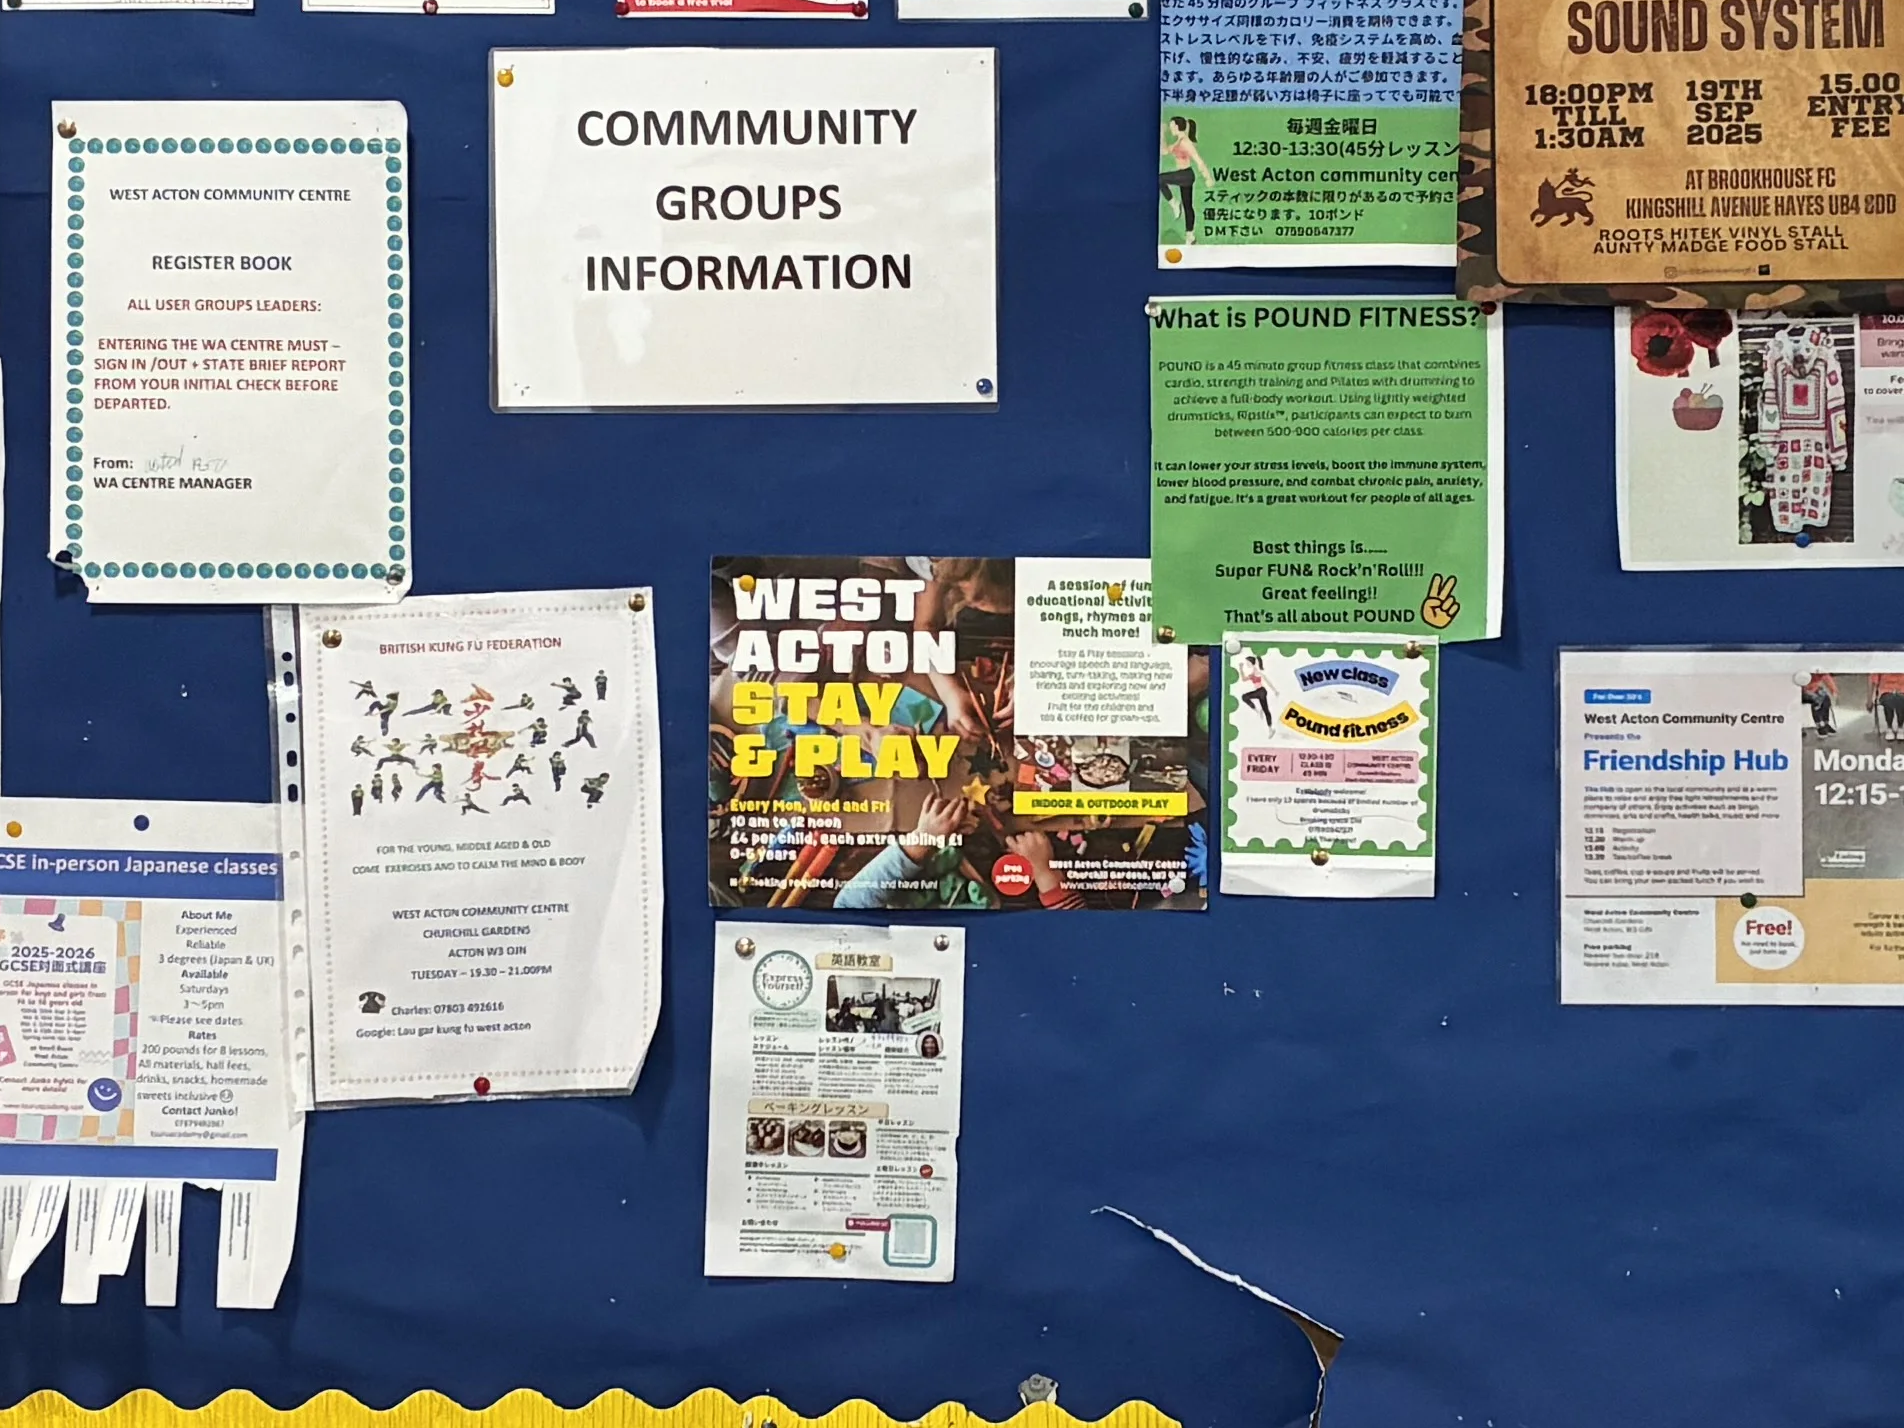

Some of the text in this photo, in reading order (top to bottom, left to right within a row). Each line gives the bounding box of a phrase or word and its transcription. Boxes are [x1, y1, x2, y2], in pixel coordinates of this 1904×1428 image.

[1567, 0, 1708, 54] SOUND
[1524, 83, 1654, 106] 18:00PM
[1686, 80, 1763, 101] 19TH
[1819, 73, 1900, 95] 15.00
[1552, 105, 1628, 127] TILL
[1695, 102, 1754, 123] SEP
[578, 108, 917, 146] COMMMUNITY
[1287, 117, 1377, 136] 毎週金曜日
[1535, 126, 1645, 149] 1:30AM
[1686, 123, 1763, 145] 2025
[1831, 117, 1891, 138] FEE
[1685, 167, 1836, 190] AT BROOKHOUSE FC
[109, 188, 351, 201] WEST ACTON COMMUNITY CENTRE
[656, 184, 842, 221] GROUPS
[1626, 197, 1706, 219] KINGSHILL
[1711, 196, 1771, 217] AVENUE
[1774, 195, 1823, 216] HAYES
[1829, 194, 1861, 215] UB4
[1599, 225, 1843, 241] ROOTS HITEK VINYL STALL
[1593, 237, 1849, 254] AUNTY MADGE FOOD STALL
[152, 255, 292, 271] REGISTER BOOK
[586, 253, 911, 291] INFORMATION
[127, 298, 321, 312] ALL USER GROUPS LEADERS:
[1155, 306, 1481, 329] What is POUND FITNESS?
[733, 578, 925, 621] WEST
[379, 636, 561, 655] BRITISH KUNG FU FEDERATION
[732, 630, 956, 675] ACTON
[1300, 667, 1390, 689] New class
[733, 682, 902, 726] STAY
[1284, 708, 1410, 738] Pound fitness
[1584, 712, 1784, 726] West Acton Community Centre
[731, 735, 960, 778] & PLAY
[1583, 749, 1789, 776] Friendship Hub
[1031, 798, 1169, 809] INDOOR & OUTDOOR PLAY
[31, 853, 119, 874] in-person
[123, 856, 209, 876] Japanese
[213, 857, 278, 875] classes
[1745, 920, 1793, 937] Free!
[11, 946, 95, 960] 2025-2026
